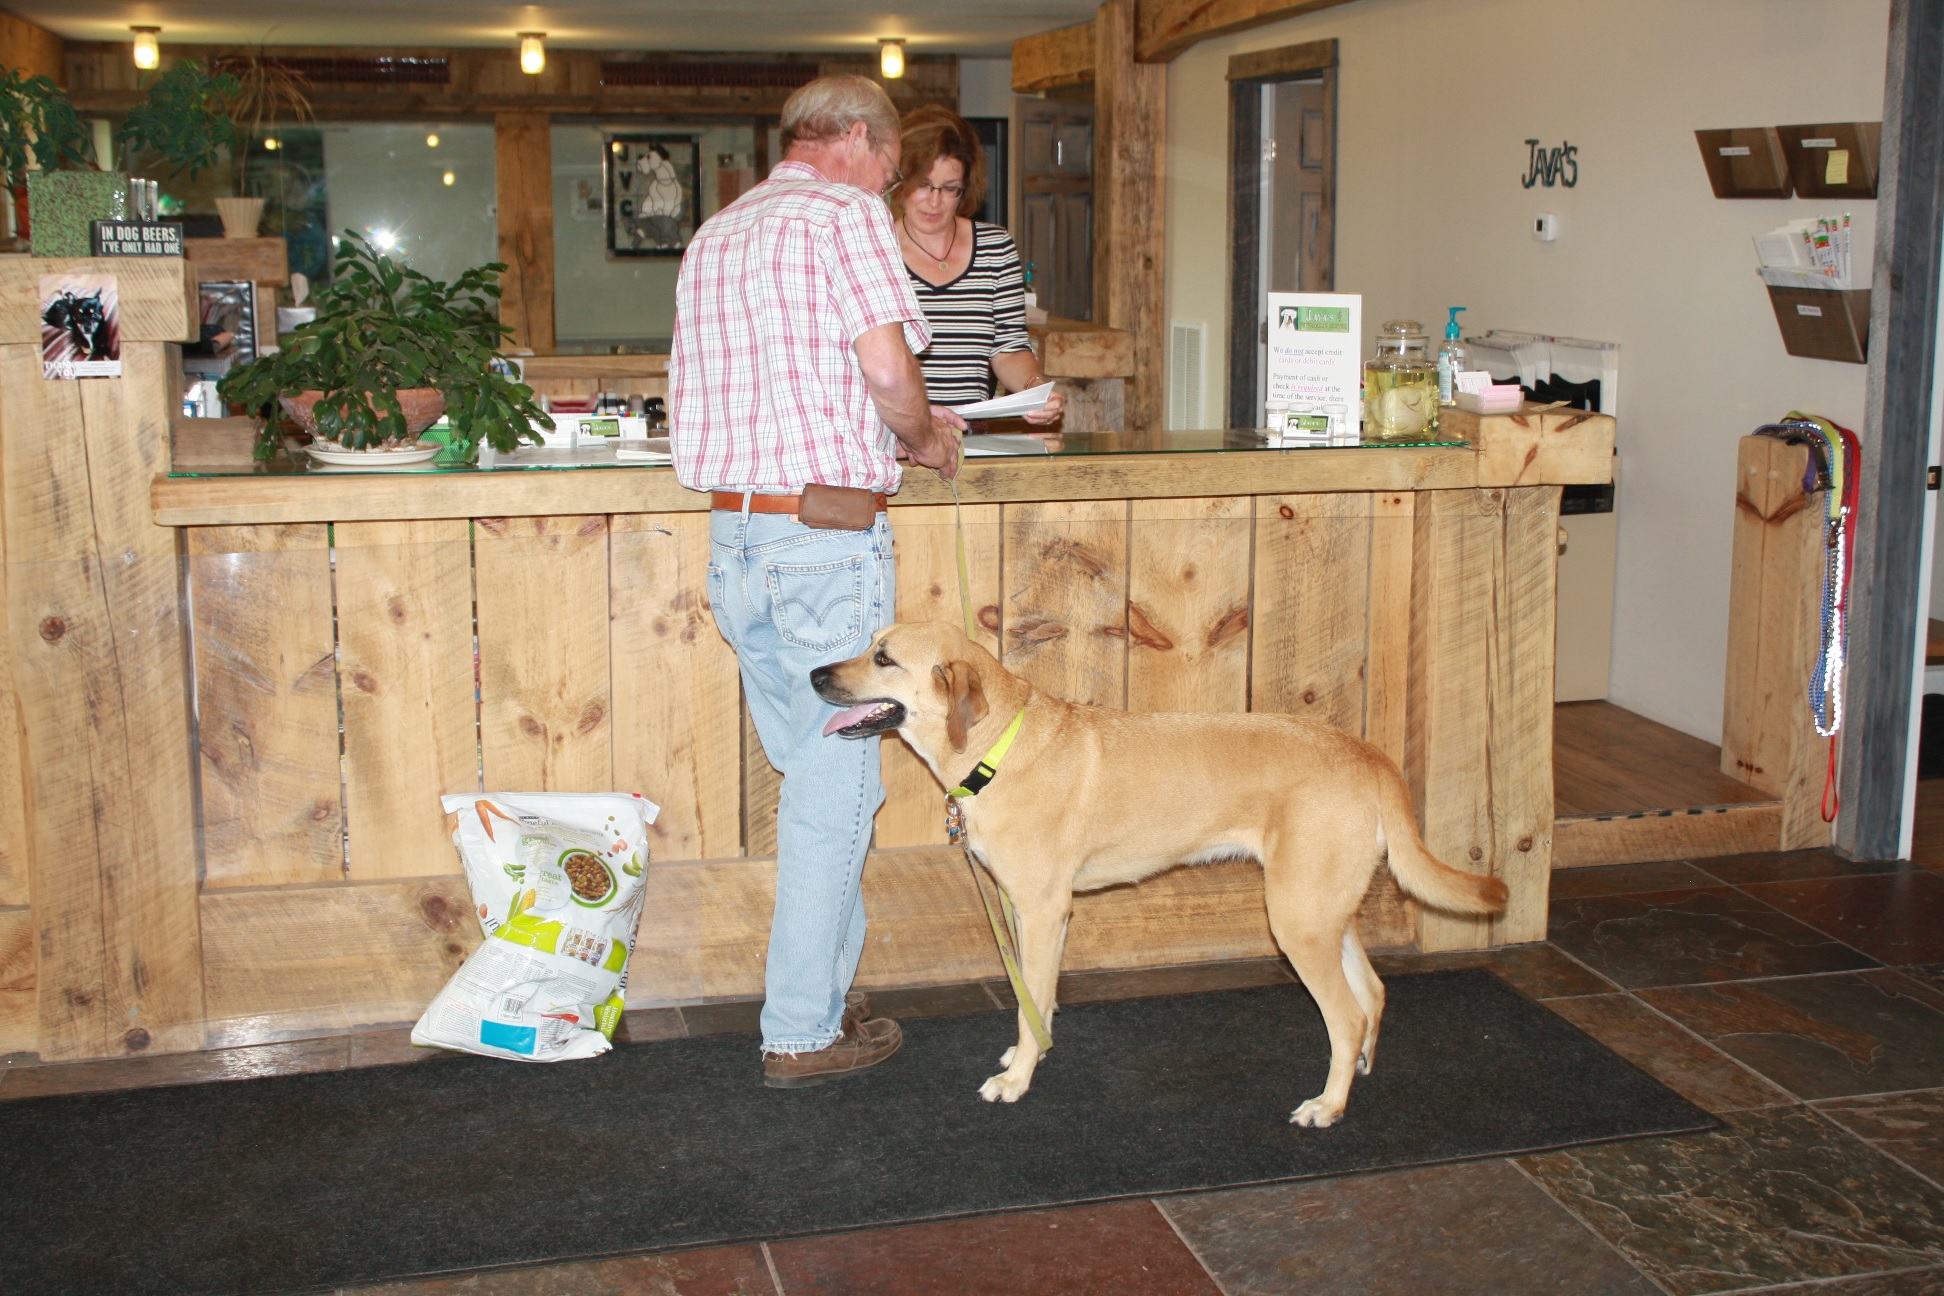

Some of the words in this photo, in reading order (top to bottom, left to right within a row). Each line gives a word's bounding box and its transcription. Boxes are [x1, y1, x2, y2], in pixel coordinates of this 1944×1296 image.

[1521, 138, 1578, 189] JAVA'S
[101, 226, 114, 240] IN
[116, 226, 140, 241] DOG
[142, 227, 179, 242] BEERS,
[102, 241, 121, 253] I'VE
[122, 241, 142, 254] ONLY
[144, 242, 162, 254] HAD
[163, 242, 181, 254] ONE
[1305, 348, 1324, 356] accept
[1272, 373, 1298, 381] Payment
[1298, 384, 1323, 392] required
[540, 870, 562, 881] reat
